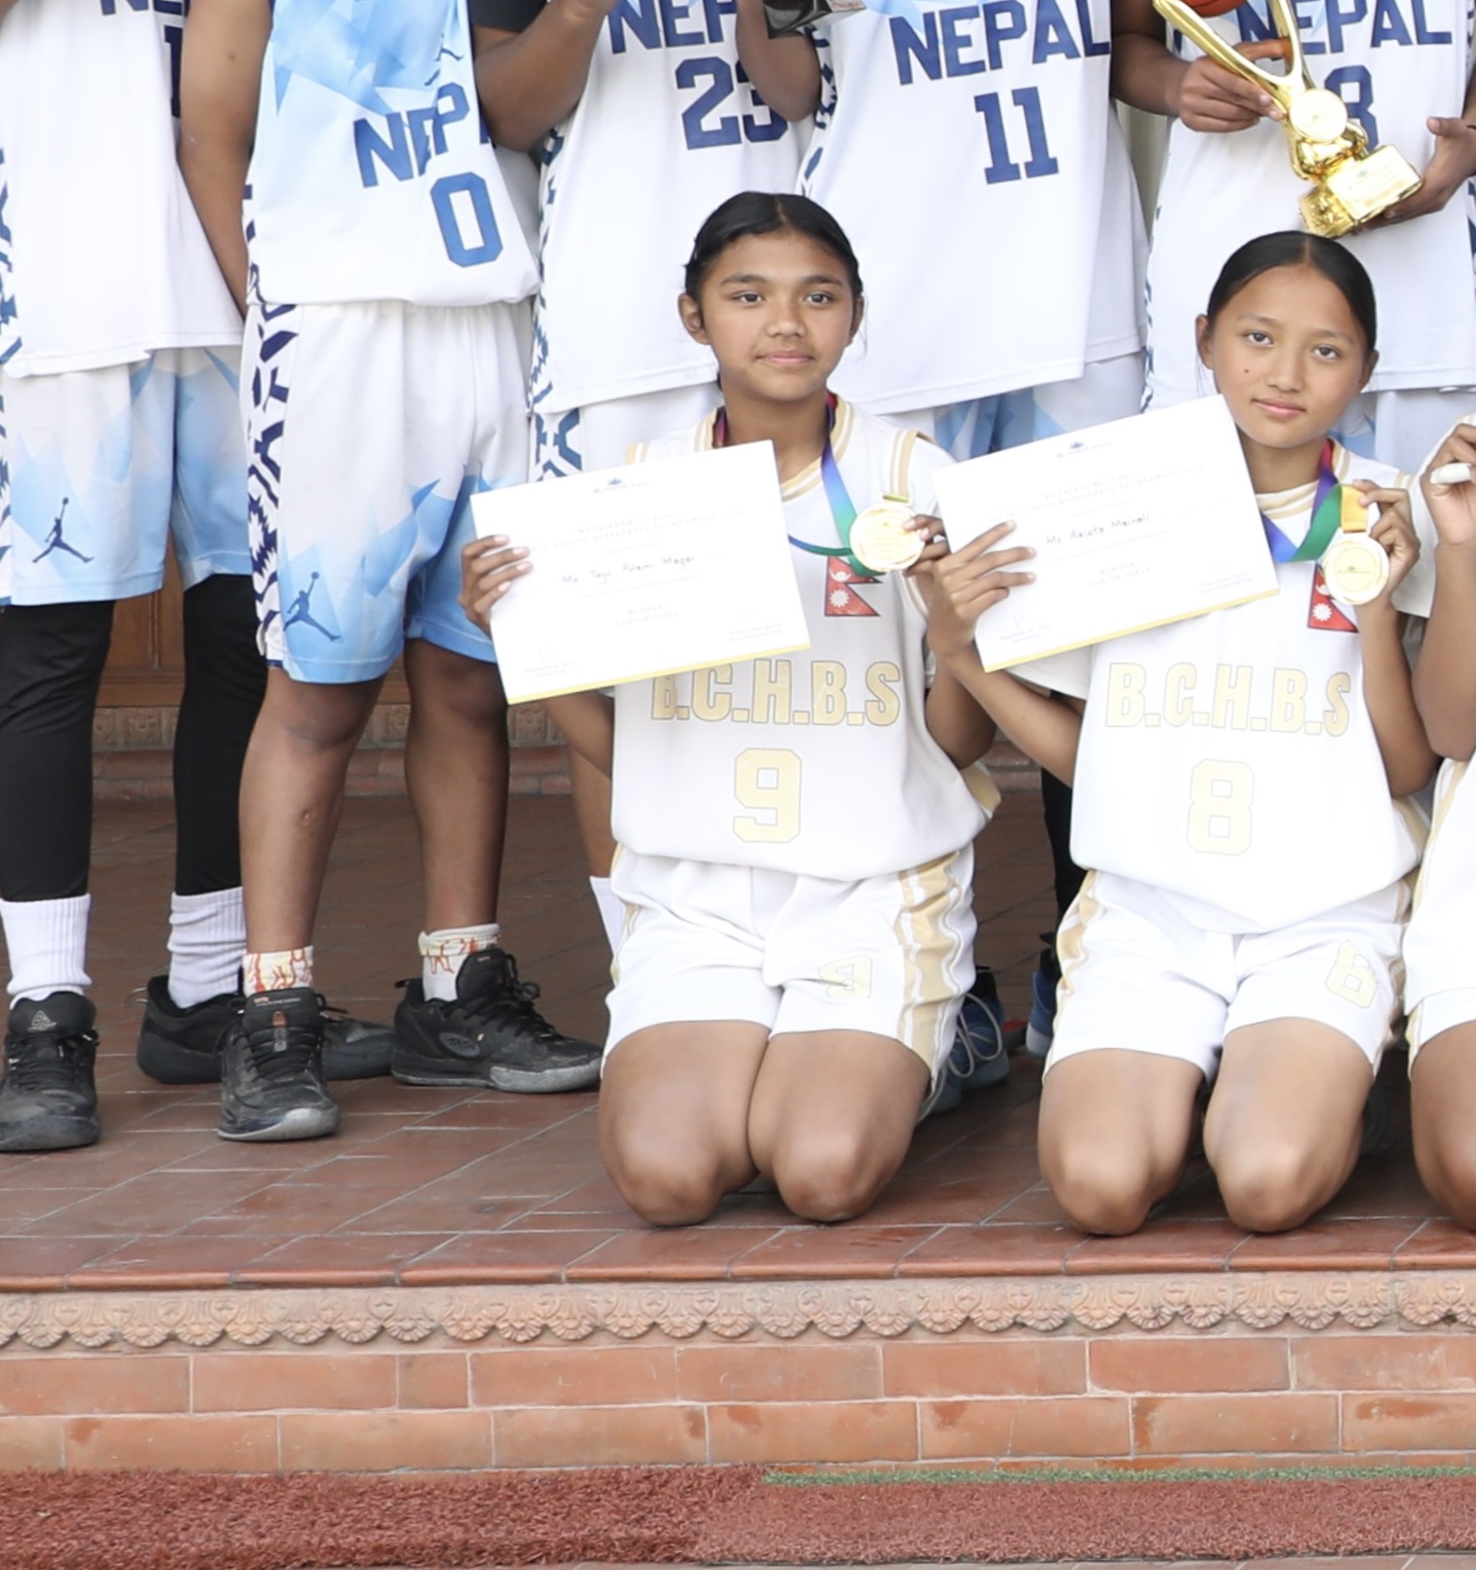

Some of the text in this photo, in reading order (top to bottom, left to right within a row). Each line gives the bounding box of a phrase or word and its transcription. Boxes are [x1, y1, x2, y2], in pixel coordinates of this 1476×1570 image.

[973, 86, 1060, 185] 11
[430, 171, 503, 268] 0
[651, 658, 901, 726] B.C.H.B.S
[1105, 662, 1352, 737] B.C.H.B.S
[732, 748, 803, 844] 9
[1185, 757, 1256, 856] 8
